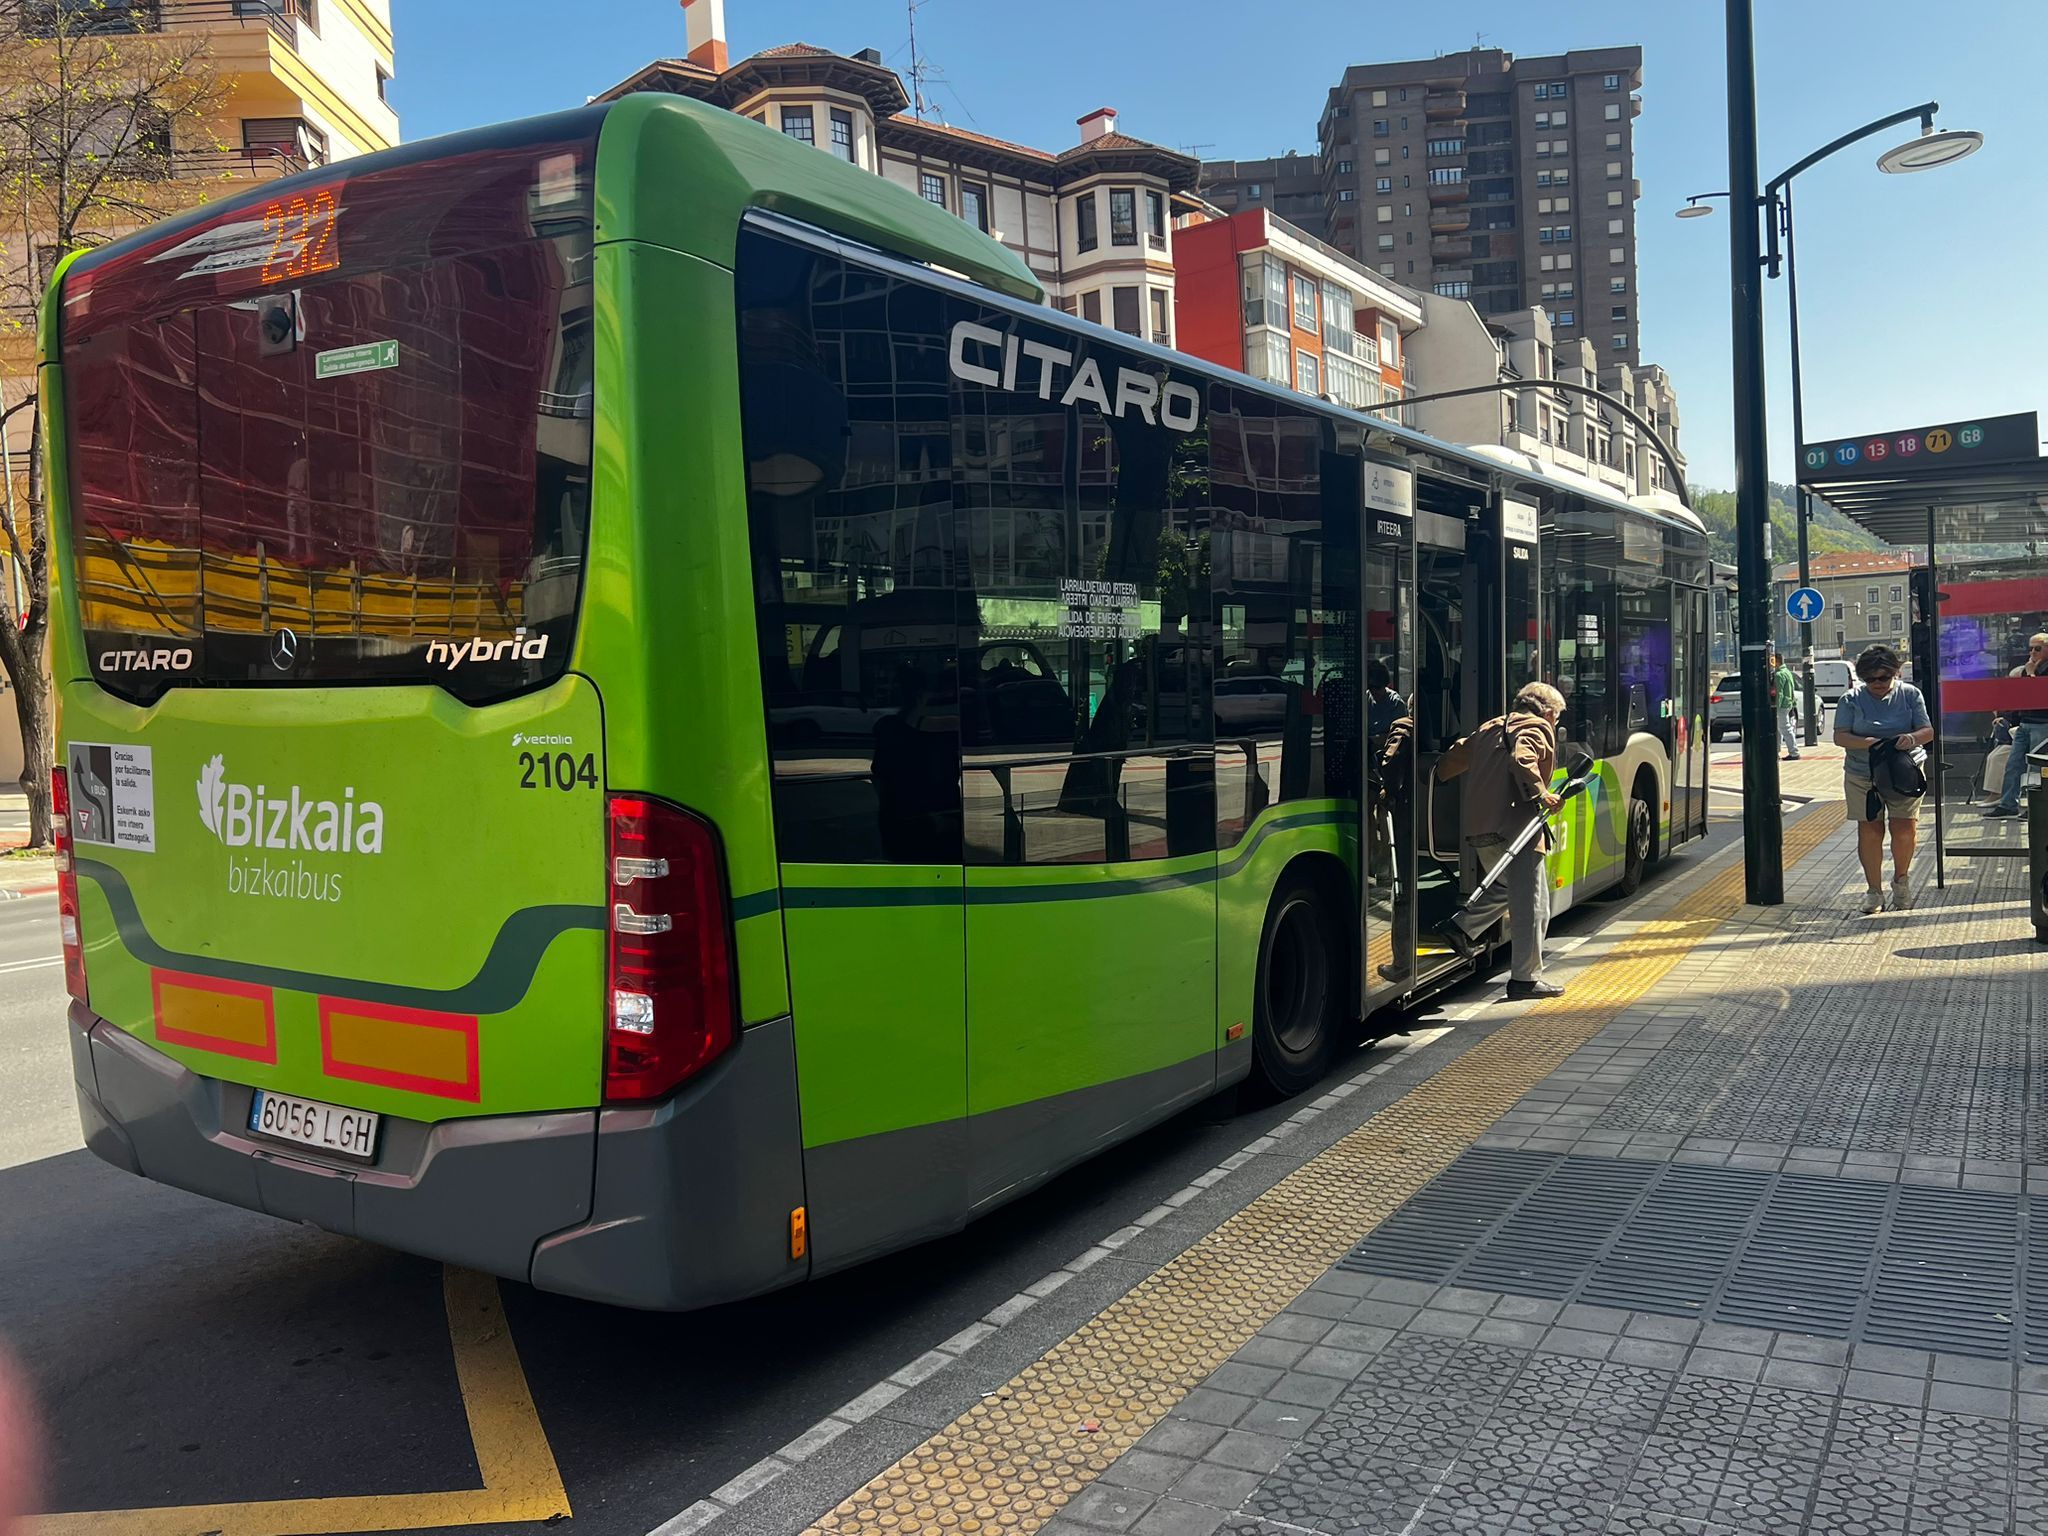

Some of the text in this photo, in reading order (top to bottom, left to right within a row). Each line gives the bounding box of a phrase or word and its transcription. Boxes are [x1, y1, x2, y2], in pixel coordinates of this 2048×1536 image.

[262, 191, 335, 282] 232
[949, 320, 1200, 433] CITARO
[1807, 429, 1981, 465] 01 10 13 18 71 G8
[1377, 520, 1402, 537] IRTEERA
[1085, 611, 1096, 623] DE
[100, 648, 193, 672] CITARO
[426, 634, 549, 671] hybrid
[523, 734, 573, 745] vectalia
[114, 751, 134, 762] Gracias
[115, 764, 151, 776] por facilitarme
[115, 778, 120, 786] la
[518, 752, 599, 791] 2104
[94, 785, 107, 796] BUS
[116, 805, 151, 817] Eskerrik asko
[226, 783, 384, 854] Bizkaia
[229, 855, 342, 902] bizkaibus
[263, 1097, 372, 1152] 6056 LGH
